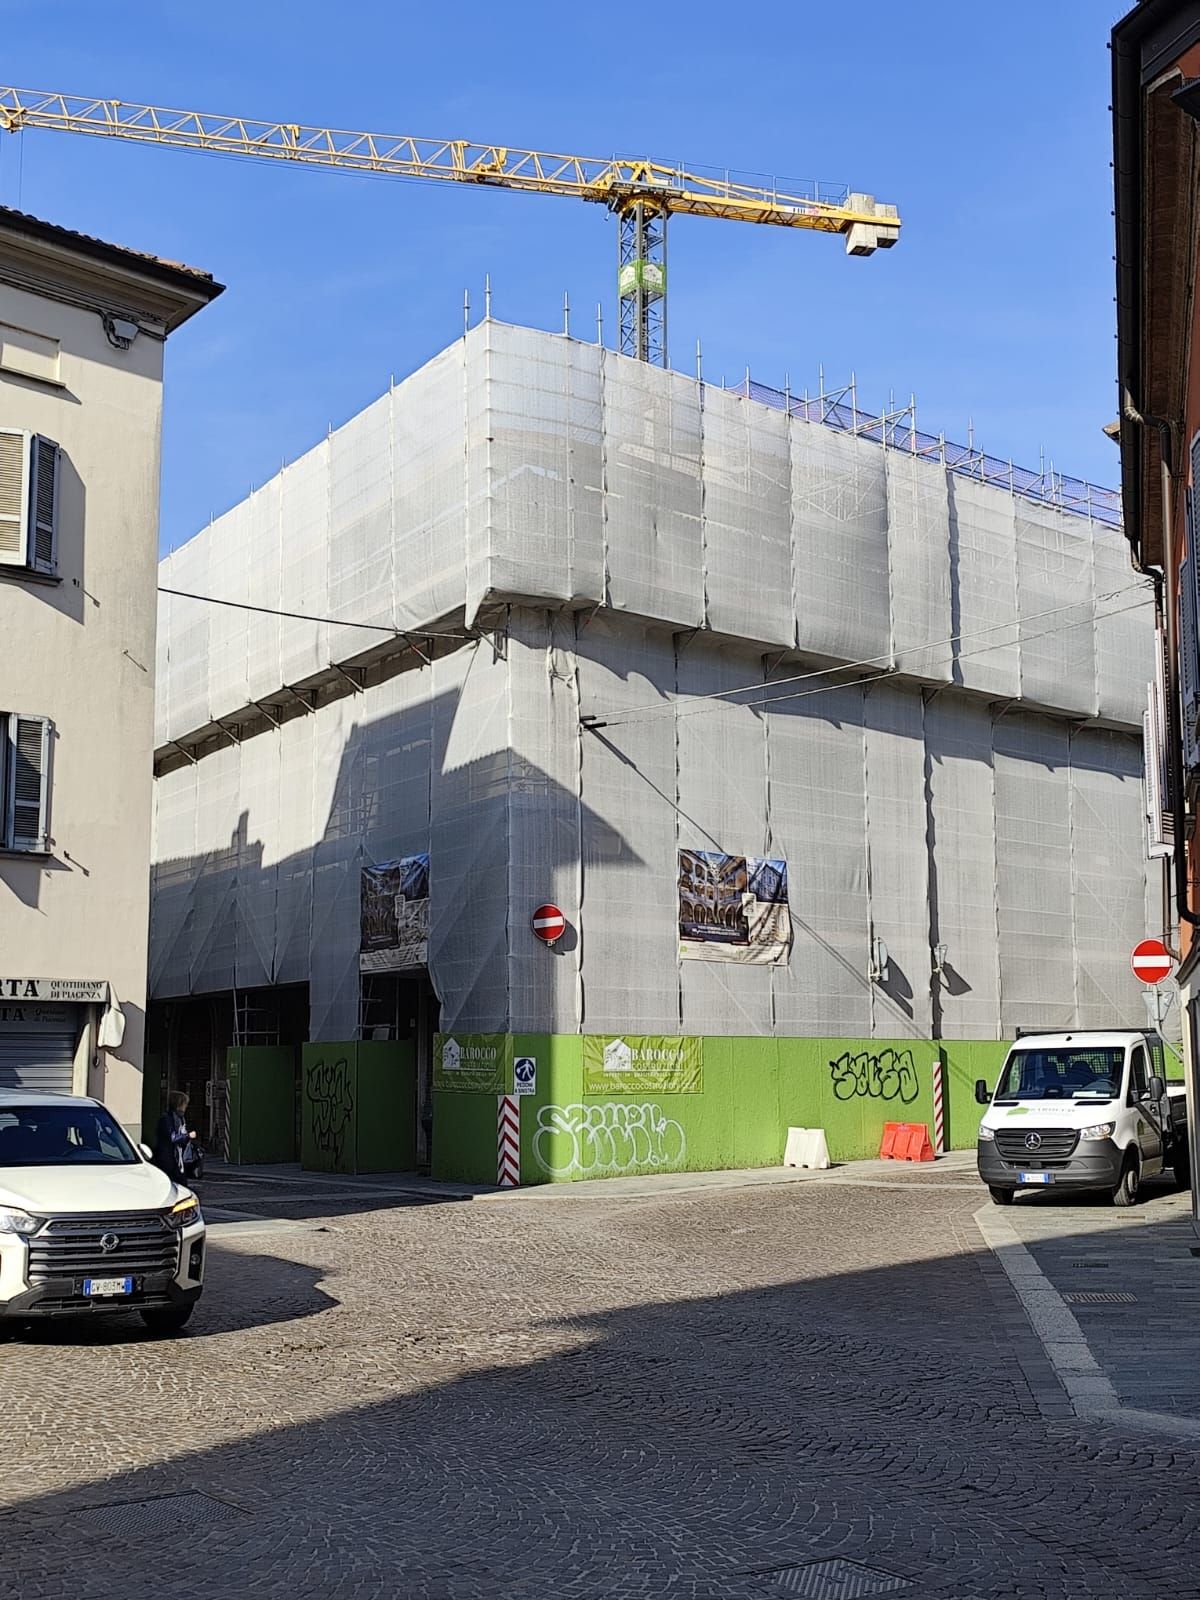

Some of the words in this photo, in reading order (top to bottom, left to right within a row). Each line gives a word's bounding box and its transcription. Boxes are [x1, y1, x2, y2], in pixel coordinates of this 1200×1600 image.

[50, 980, 102, 989] QUOTIDIANO
[50, 991, 60, 999] DI
[62, 991, 101, 999] PIACENZA
[460, 1047, 497, 1059] BAROCCO
[631, 1048, 684, 1061] BAROCCO
